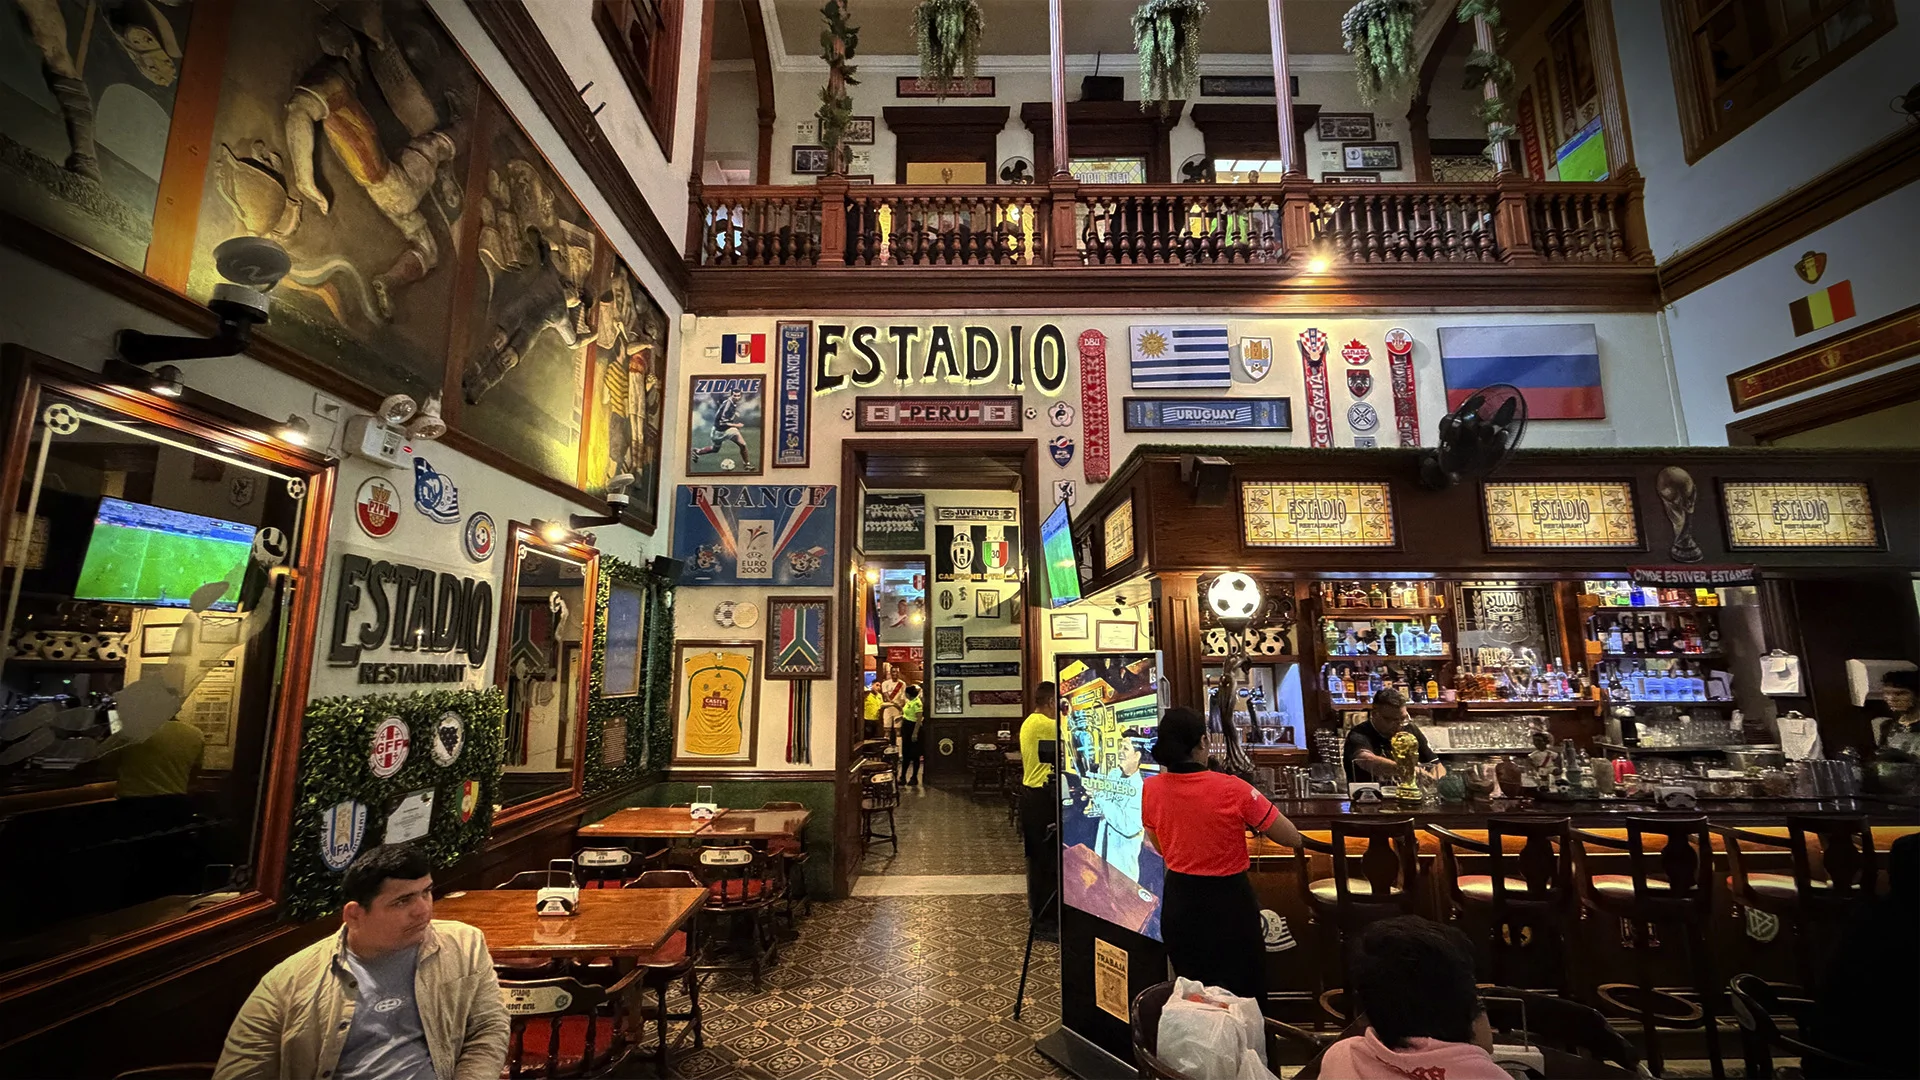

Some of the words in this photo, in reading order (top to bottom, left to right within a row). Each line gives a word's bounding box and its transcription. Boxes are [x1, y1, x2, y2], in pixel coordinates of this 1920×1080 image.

[1084, 338, 1100, 346] DBU
[815, 323, 1067, 392] ESTADIO
[786, 353, 800, 391] FRANCE
[695, 378, 762, 394] ZIDANE
[909, 405, 971, 422] PERU
[1087, 356, 1103, 457] DANMARK
[1175, 408, 1238, 421] URUGUAY
[1309, 373, 1328, 444] CROAZIA
[785, 404, 799, 433] ALLEZ
[688, 485, 828, 508] FRANCE
[368, 500, 390, 517] PZPN
[1287, 498, 1347, 525] ESTADIO
[1530, 498, 1590, 525] ESTADIO
[1771, 499, 1830, 525] ESTADIO
[990, 550, 1000, 559] 30
[1483, 592, 1526, 609] ESTADIO
[328, 553, 493, 670] ESTADIO
[358, 662, 466, 684] RESTAURANT
[376, 739, 403, 755] GFF
[1081, 777, 1137, 797] FUTBOLERO
[333, 843, 350, 857] IFA
[1097, 952, 1126, 972] TRABAJA
